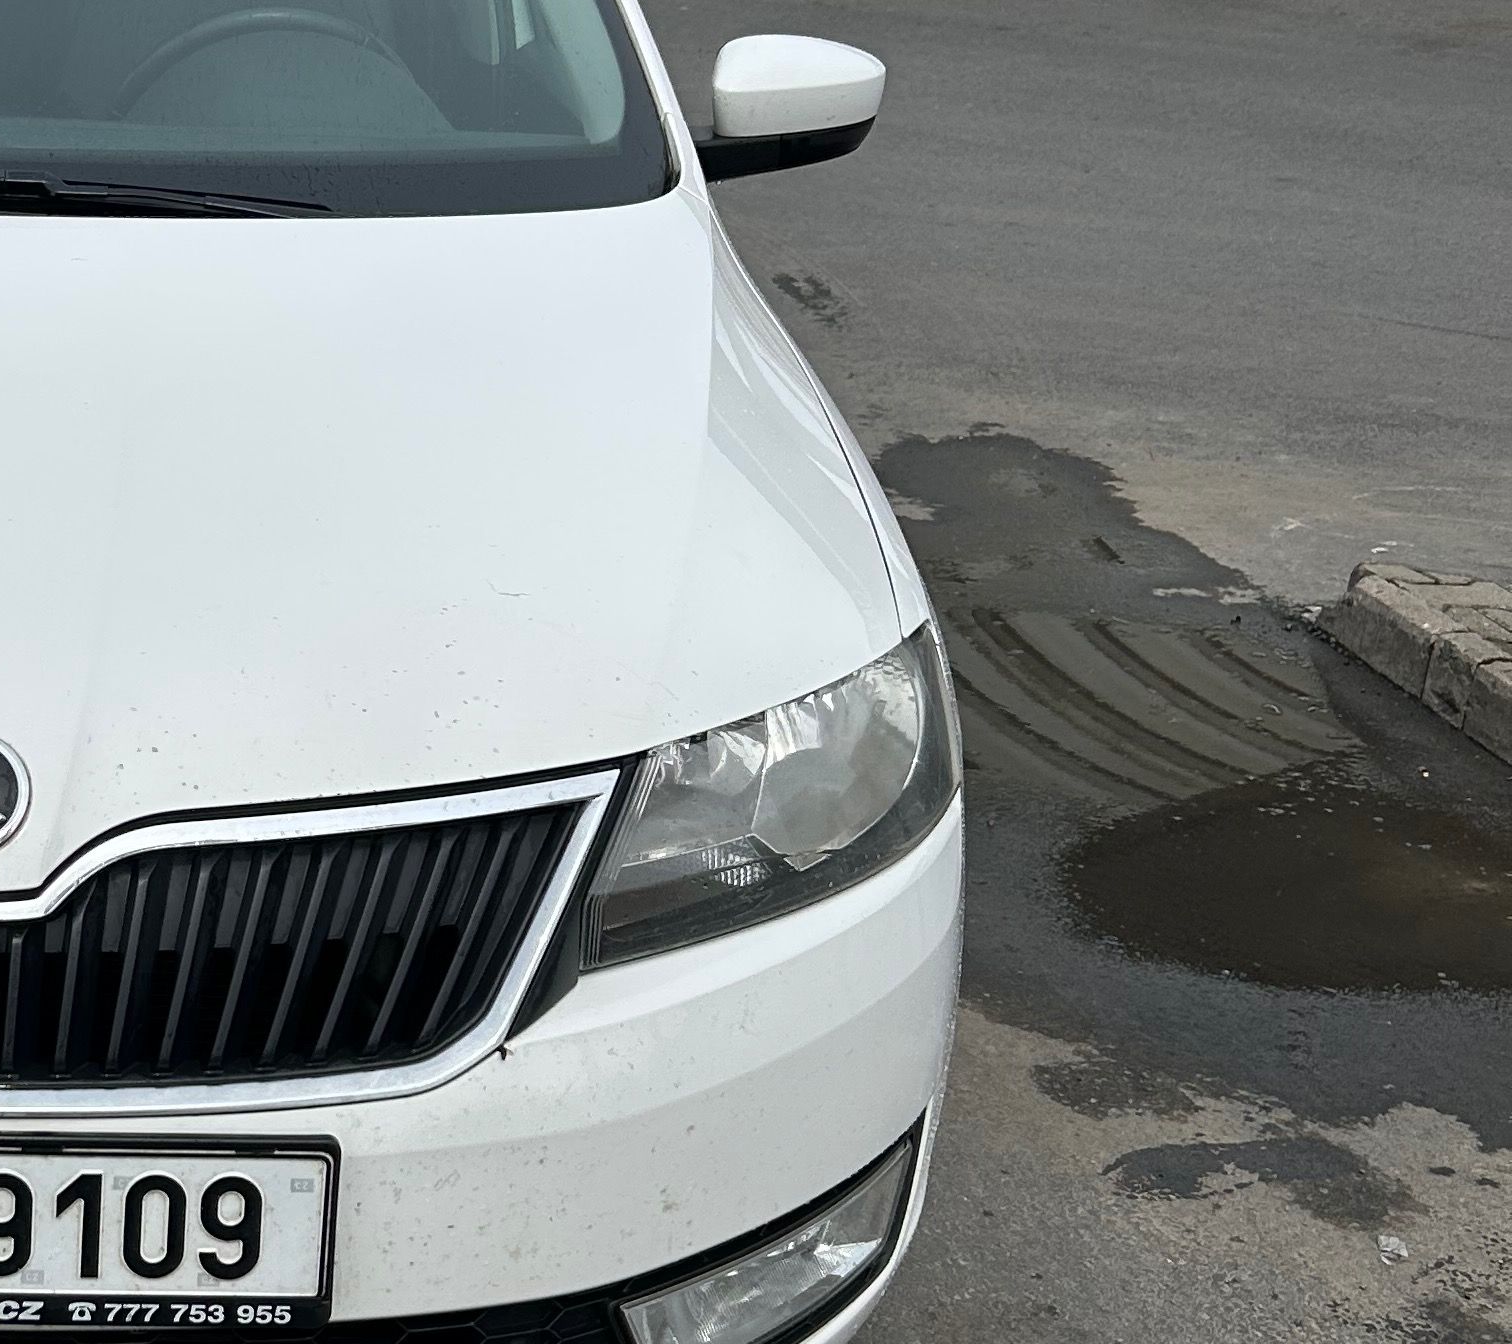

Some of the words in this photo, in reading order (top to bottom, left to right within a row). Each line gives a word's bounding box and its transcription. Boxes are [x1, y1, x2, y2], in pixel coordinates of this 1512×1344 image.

[104, 1303, 159, 1323] 777
[171, 1304, 225, 1324] 753
[237, 1305, 292, 1325] 955
